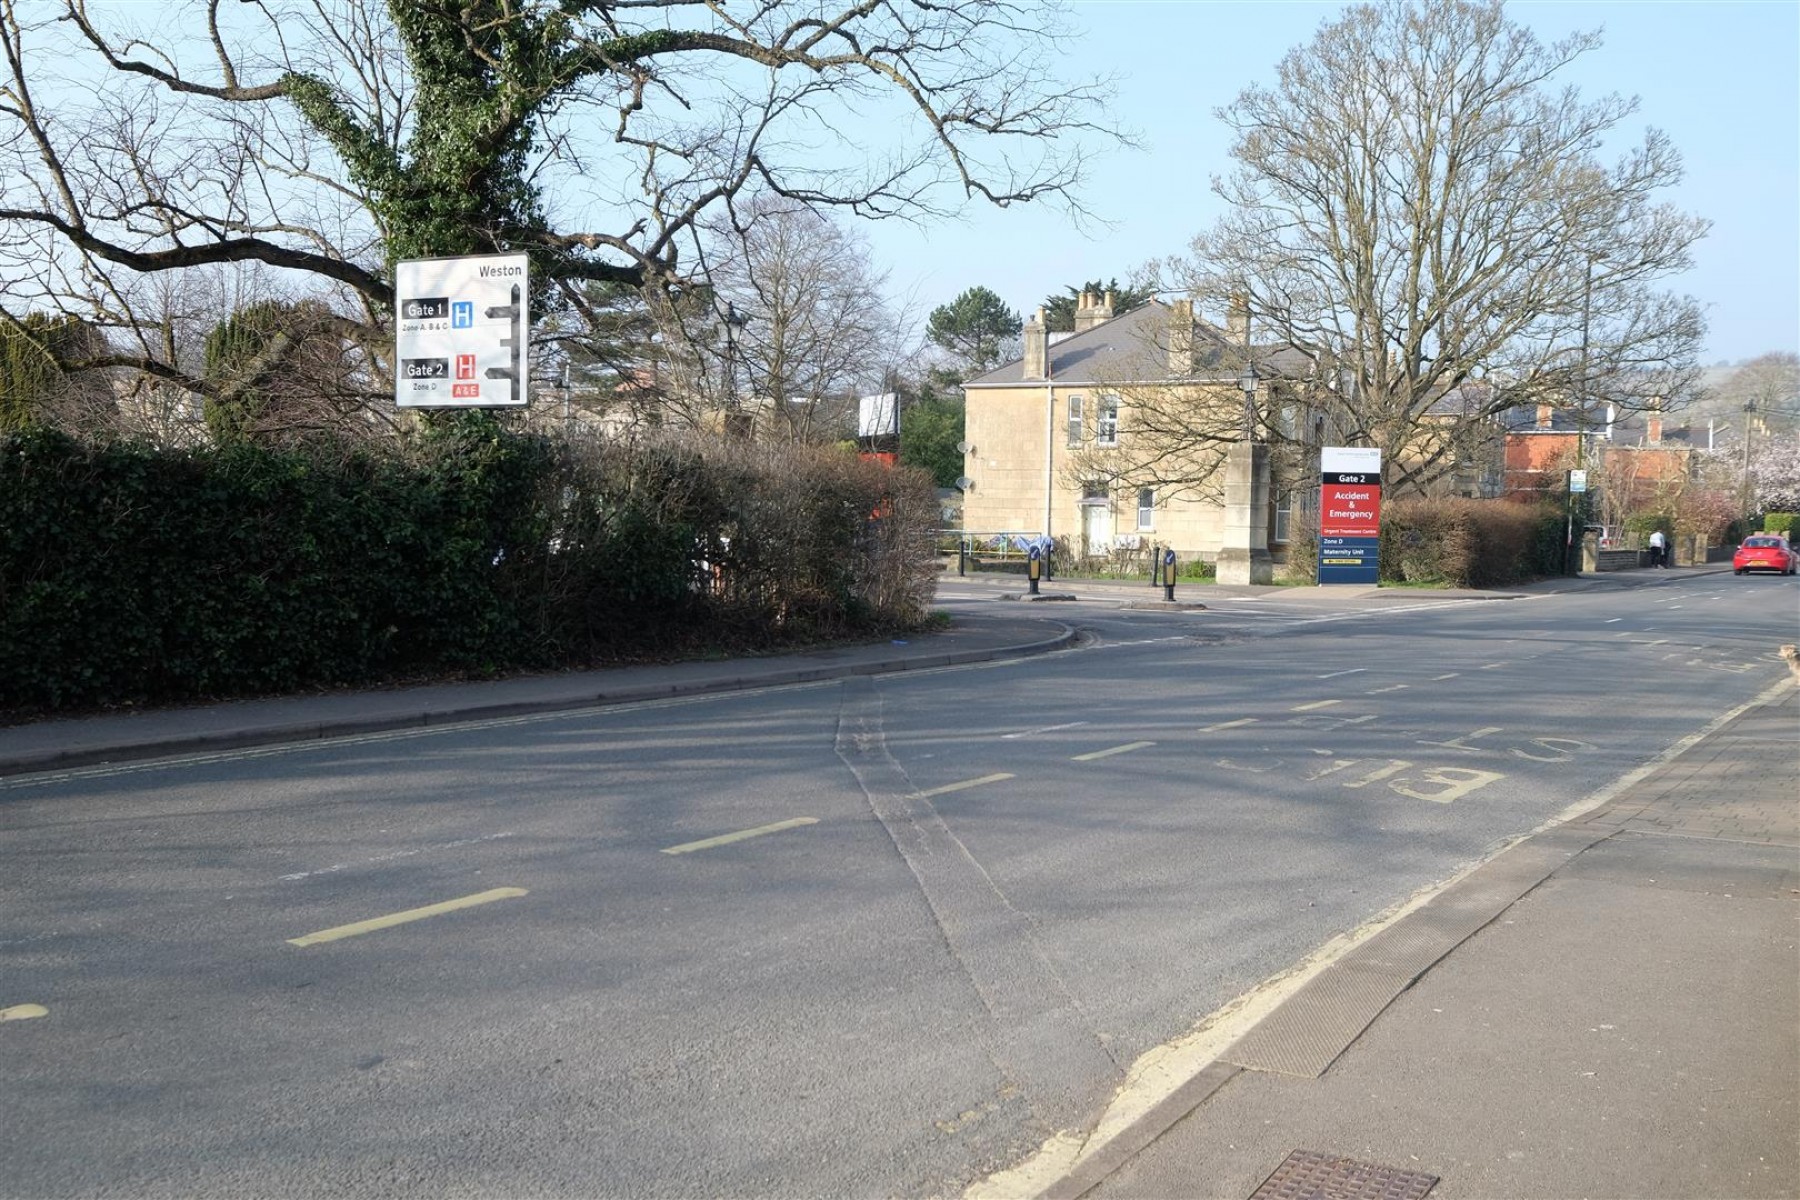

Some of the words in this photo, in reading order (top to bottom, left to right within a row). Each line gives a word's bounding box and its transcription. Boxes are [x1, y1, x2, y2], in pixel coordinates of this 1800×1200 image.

[479, 266, 522, 278] Weston
[408, 304, 434, 316] Gate
[437, 304, 442, 315] 1
[456, 305, 469, 326] H
[407, 364, 433, 376] Gate
[436, 364, 443, 375] 2
[459, 357, 473, 378] H
[455, 386, 477, 395] A&E
[1339, 474, 1358, 482] Gate
[1335, 492, 1369, 500] Accident
[1329, 510, 1373, 519] Emergency
